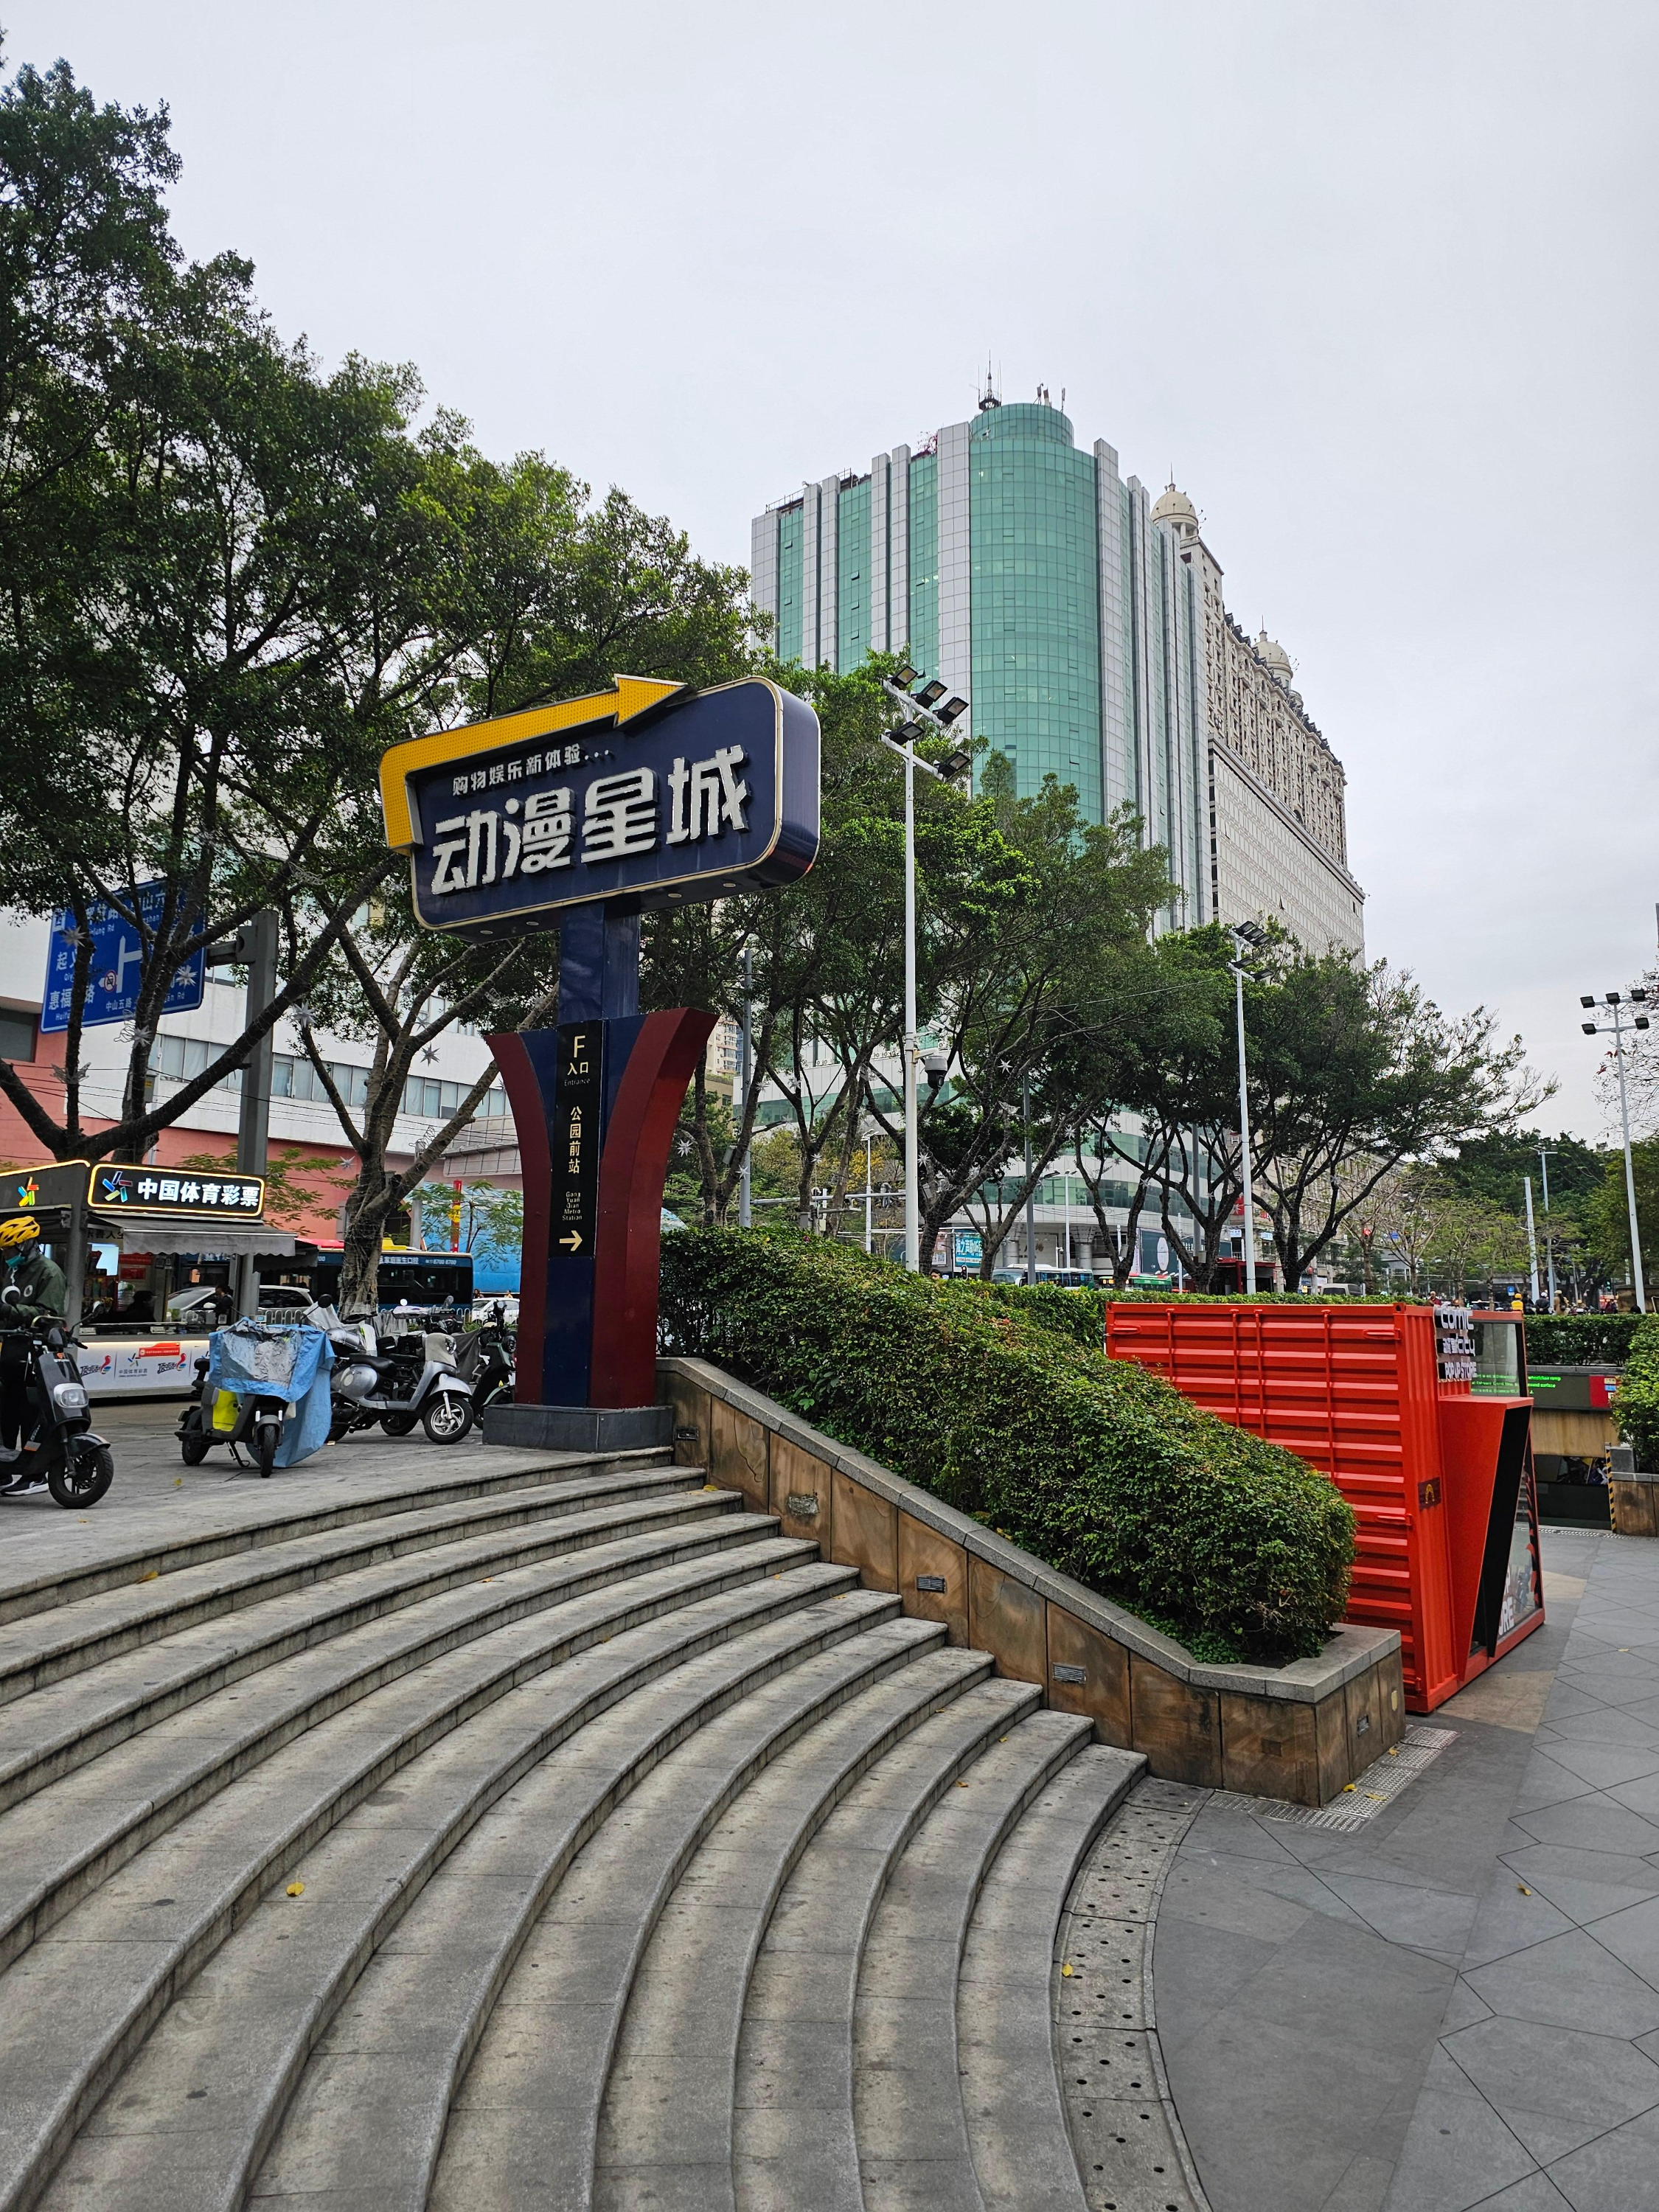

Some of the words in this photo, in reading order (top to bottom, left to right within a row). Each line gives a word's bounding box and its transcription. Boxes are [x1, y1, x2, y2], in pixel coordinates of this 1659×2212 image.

[431, 745, 748, 895] 动漫星城
[48, 983, 96, 1010] 惠福路
[105, 997, 132, 1012] 中山五路
[574, 1035, 585, 1058] F
[567, 1061, 588, 1076] 入口
[564, 1078, 591, 1087] Entrance
[568, 1106, 582, 1174] 公园前站
[138, 1178, 260, 1207] 中国体育彩票
